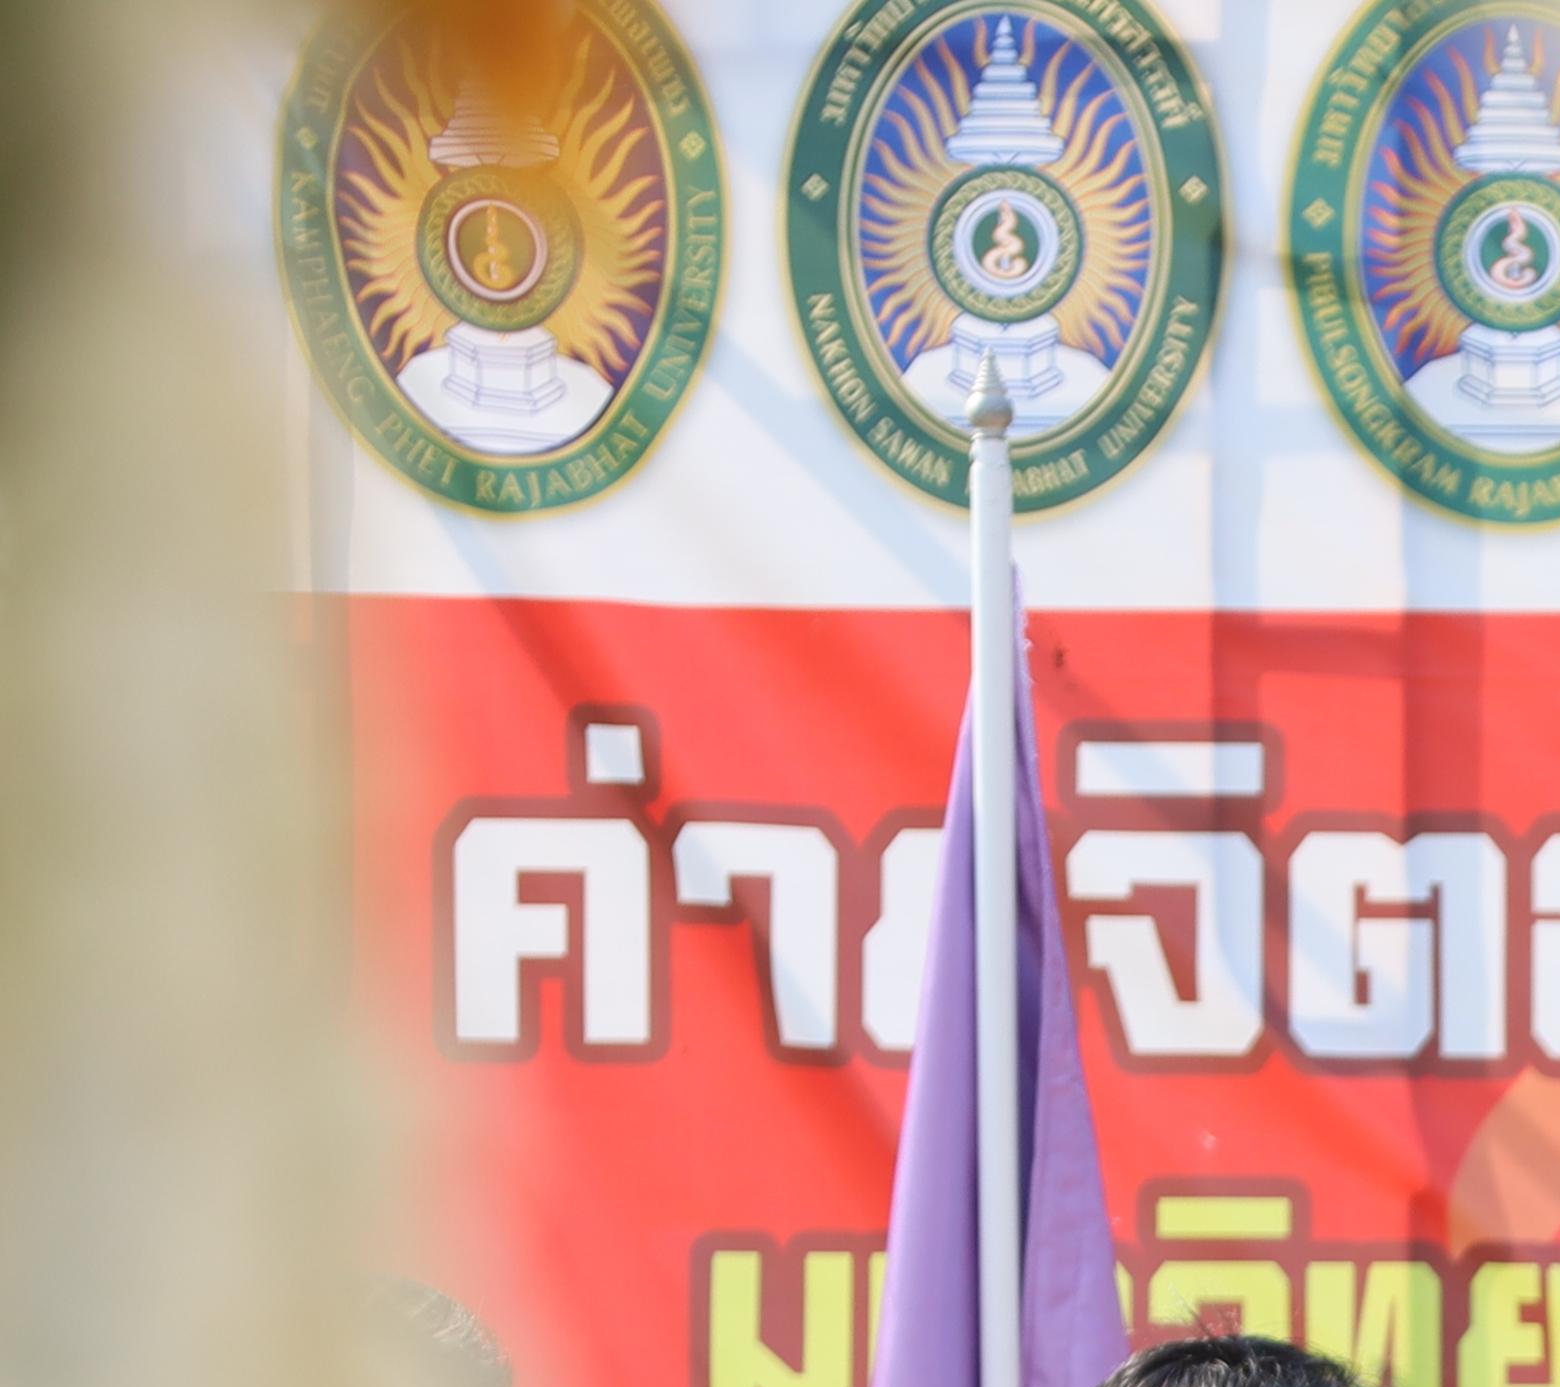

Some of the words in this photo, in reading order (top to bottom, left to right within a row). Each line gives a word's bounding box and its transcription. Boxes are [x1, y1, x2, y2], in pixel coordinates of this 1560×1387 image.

[375, 411, 459, 488] PHET
[475, 412, 648, 508] RAJABHAT
[643, 184, 718, 401] UNIVERSITY
[806, 292, 878, 423] NAKHON
[868, 417, 953, 488] SAWAN
[1103, 295, 1201, 459] UNIVERSITY
